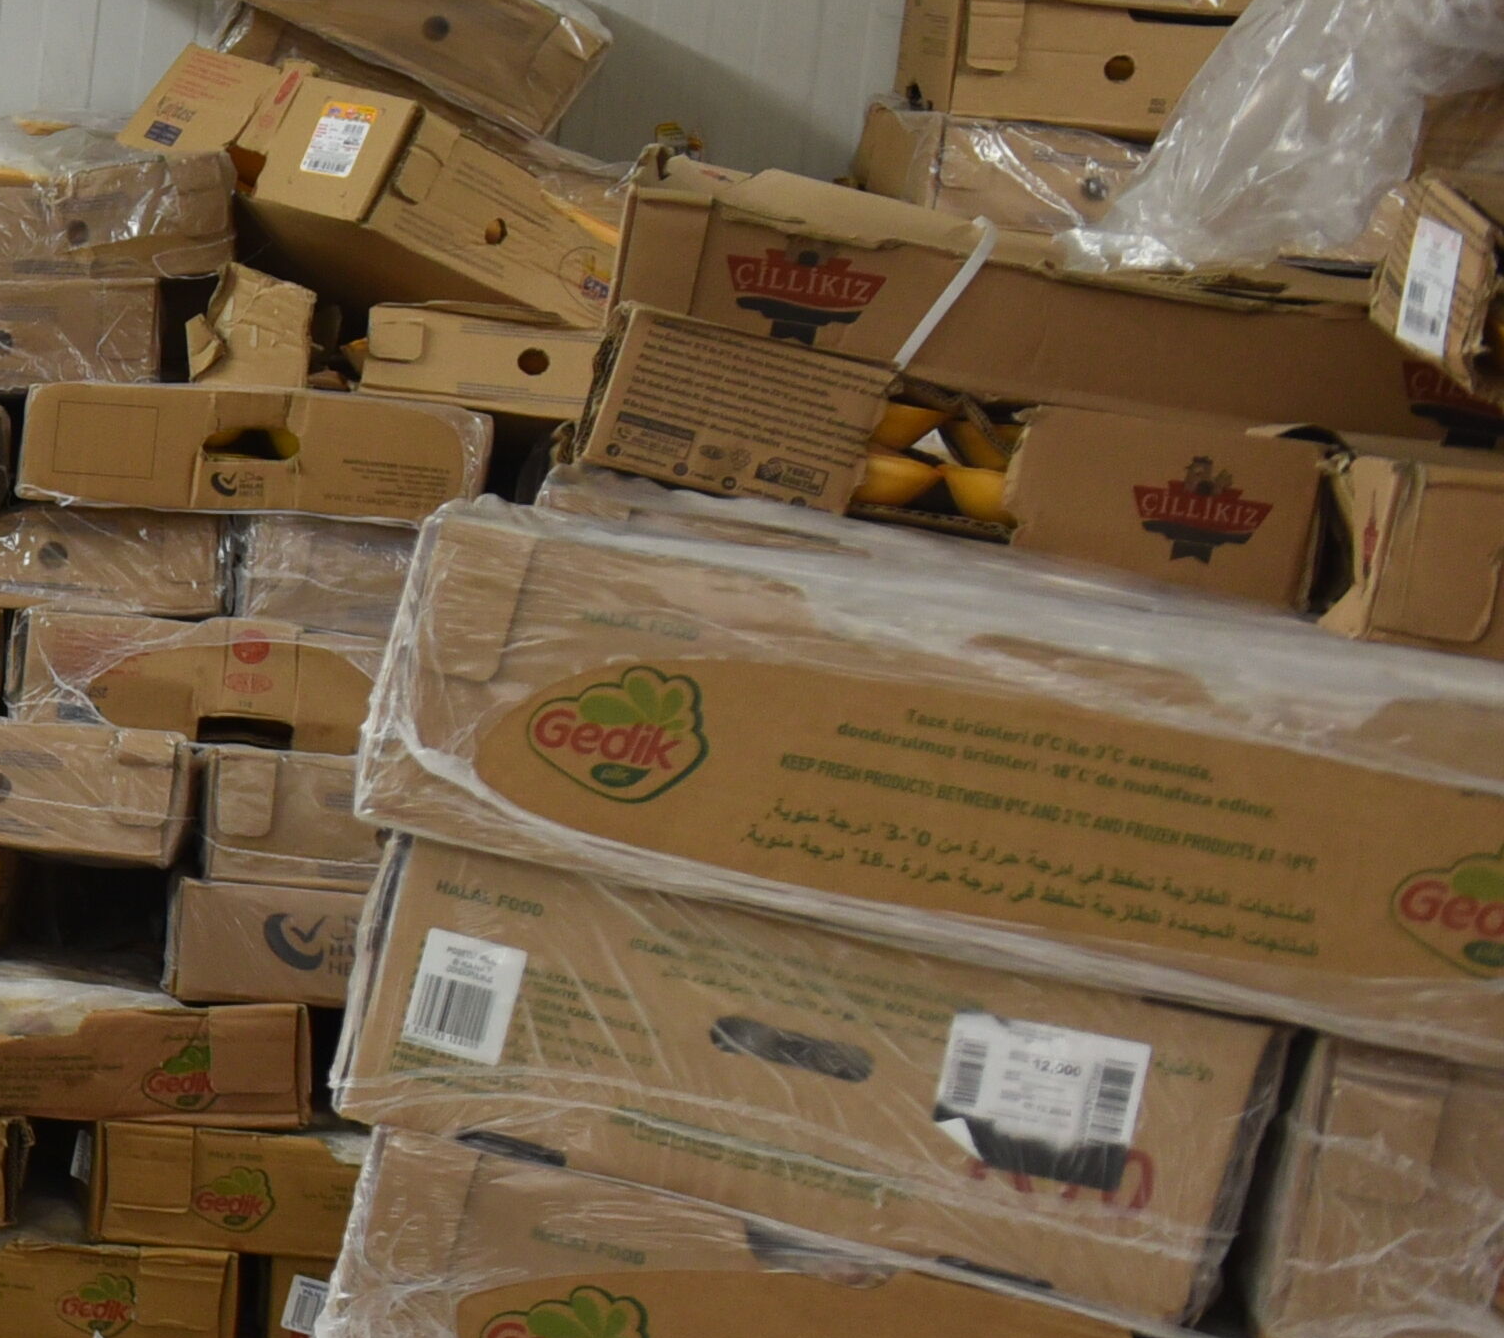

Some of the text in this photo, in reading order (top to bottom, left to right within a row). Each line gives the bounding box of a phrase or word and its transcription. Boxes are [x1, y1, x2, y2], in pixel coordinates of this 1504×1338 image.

[735, 260, 871, 307] ÇİLLİKIZ
[1141, 491, 1262, 532] ÇİLLİKIZ
[534, 708, 680, 770] Gedik
[436, 878, 545, 918] HALAL FOOD
[196, 1188, 264, 1216] Gedik
